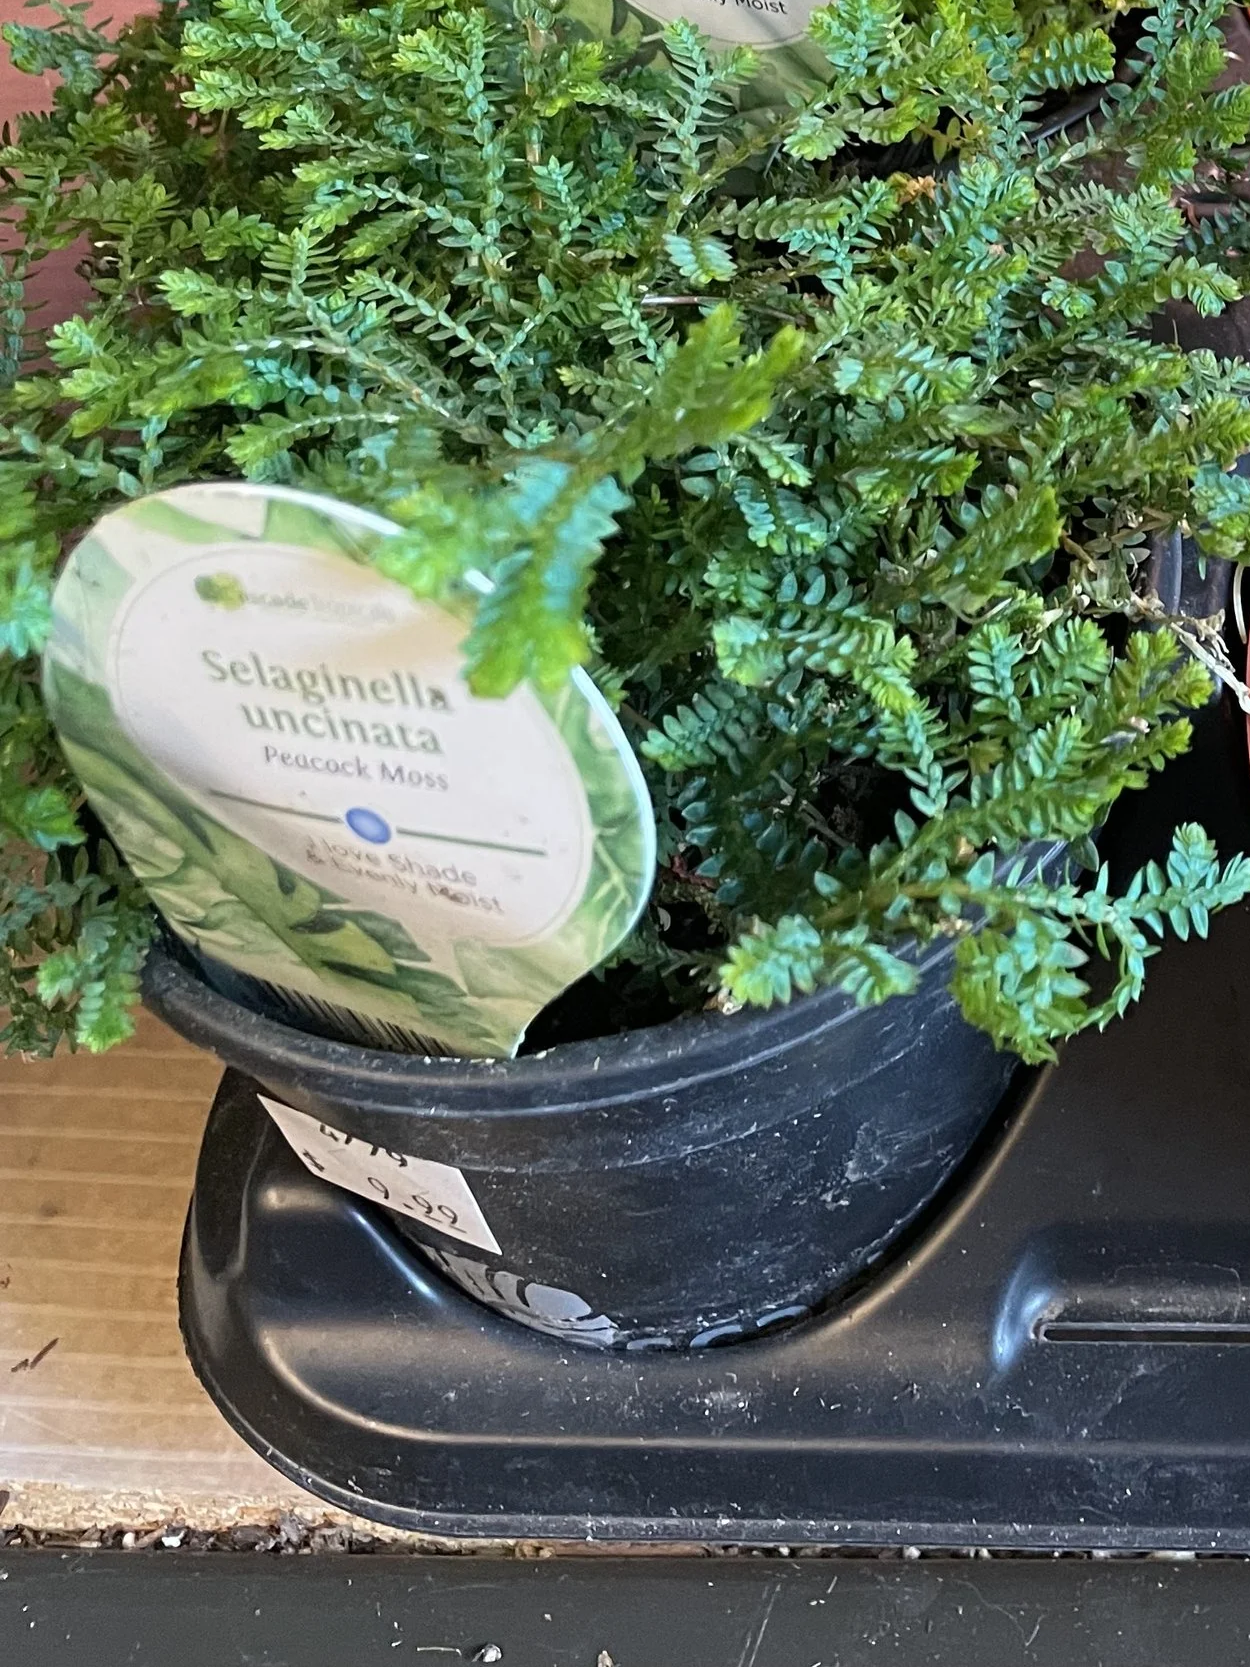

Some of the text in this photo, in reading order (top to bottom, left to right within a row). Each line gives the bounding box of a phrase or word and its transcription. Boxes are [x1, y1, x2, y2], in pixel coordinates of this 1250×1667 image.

[201, 649, 454, 715] Selaginella
[240, 703, 443, 754] uncinata
[264, 745, 448, 791] Peacock Moss
[321, 837, 380, 866] love
[388, 853, 477, 887] Shade
